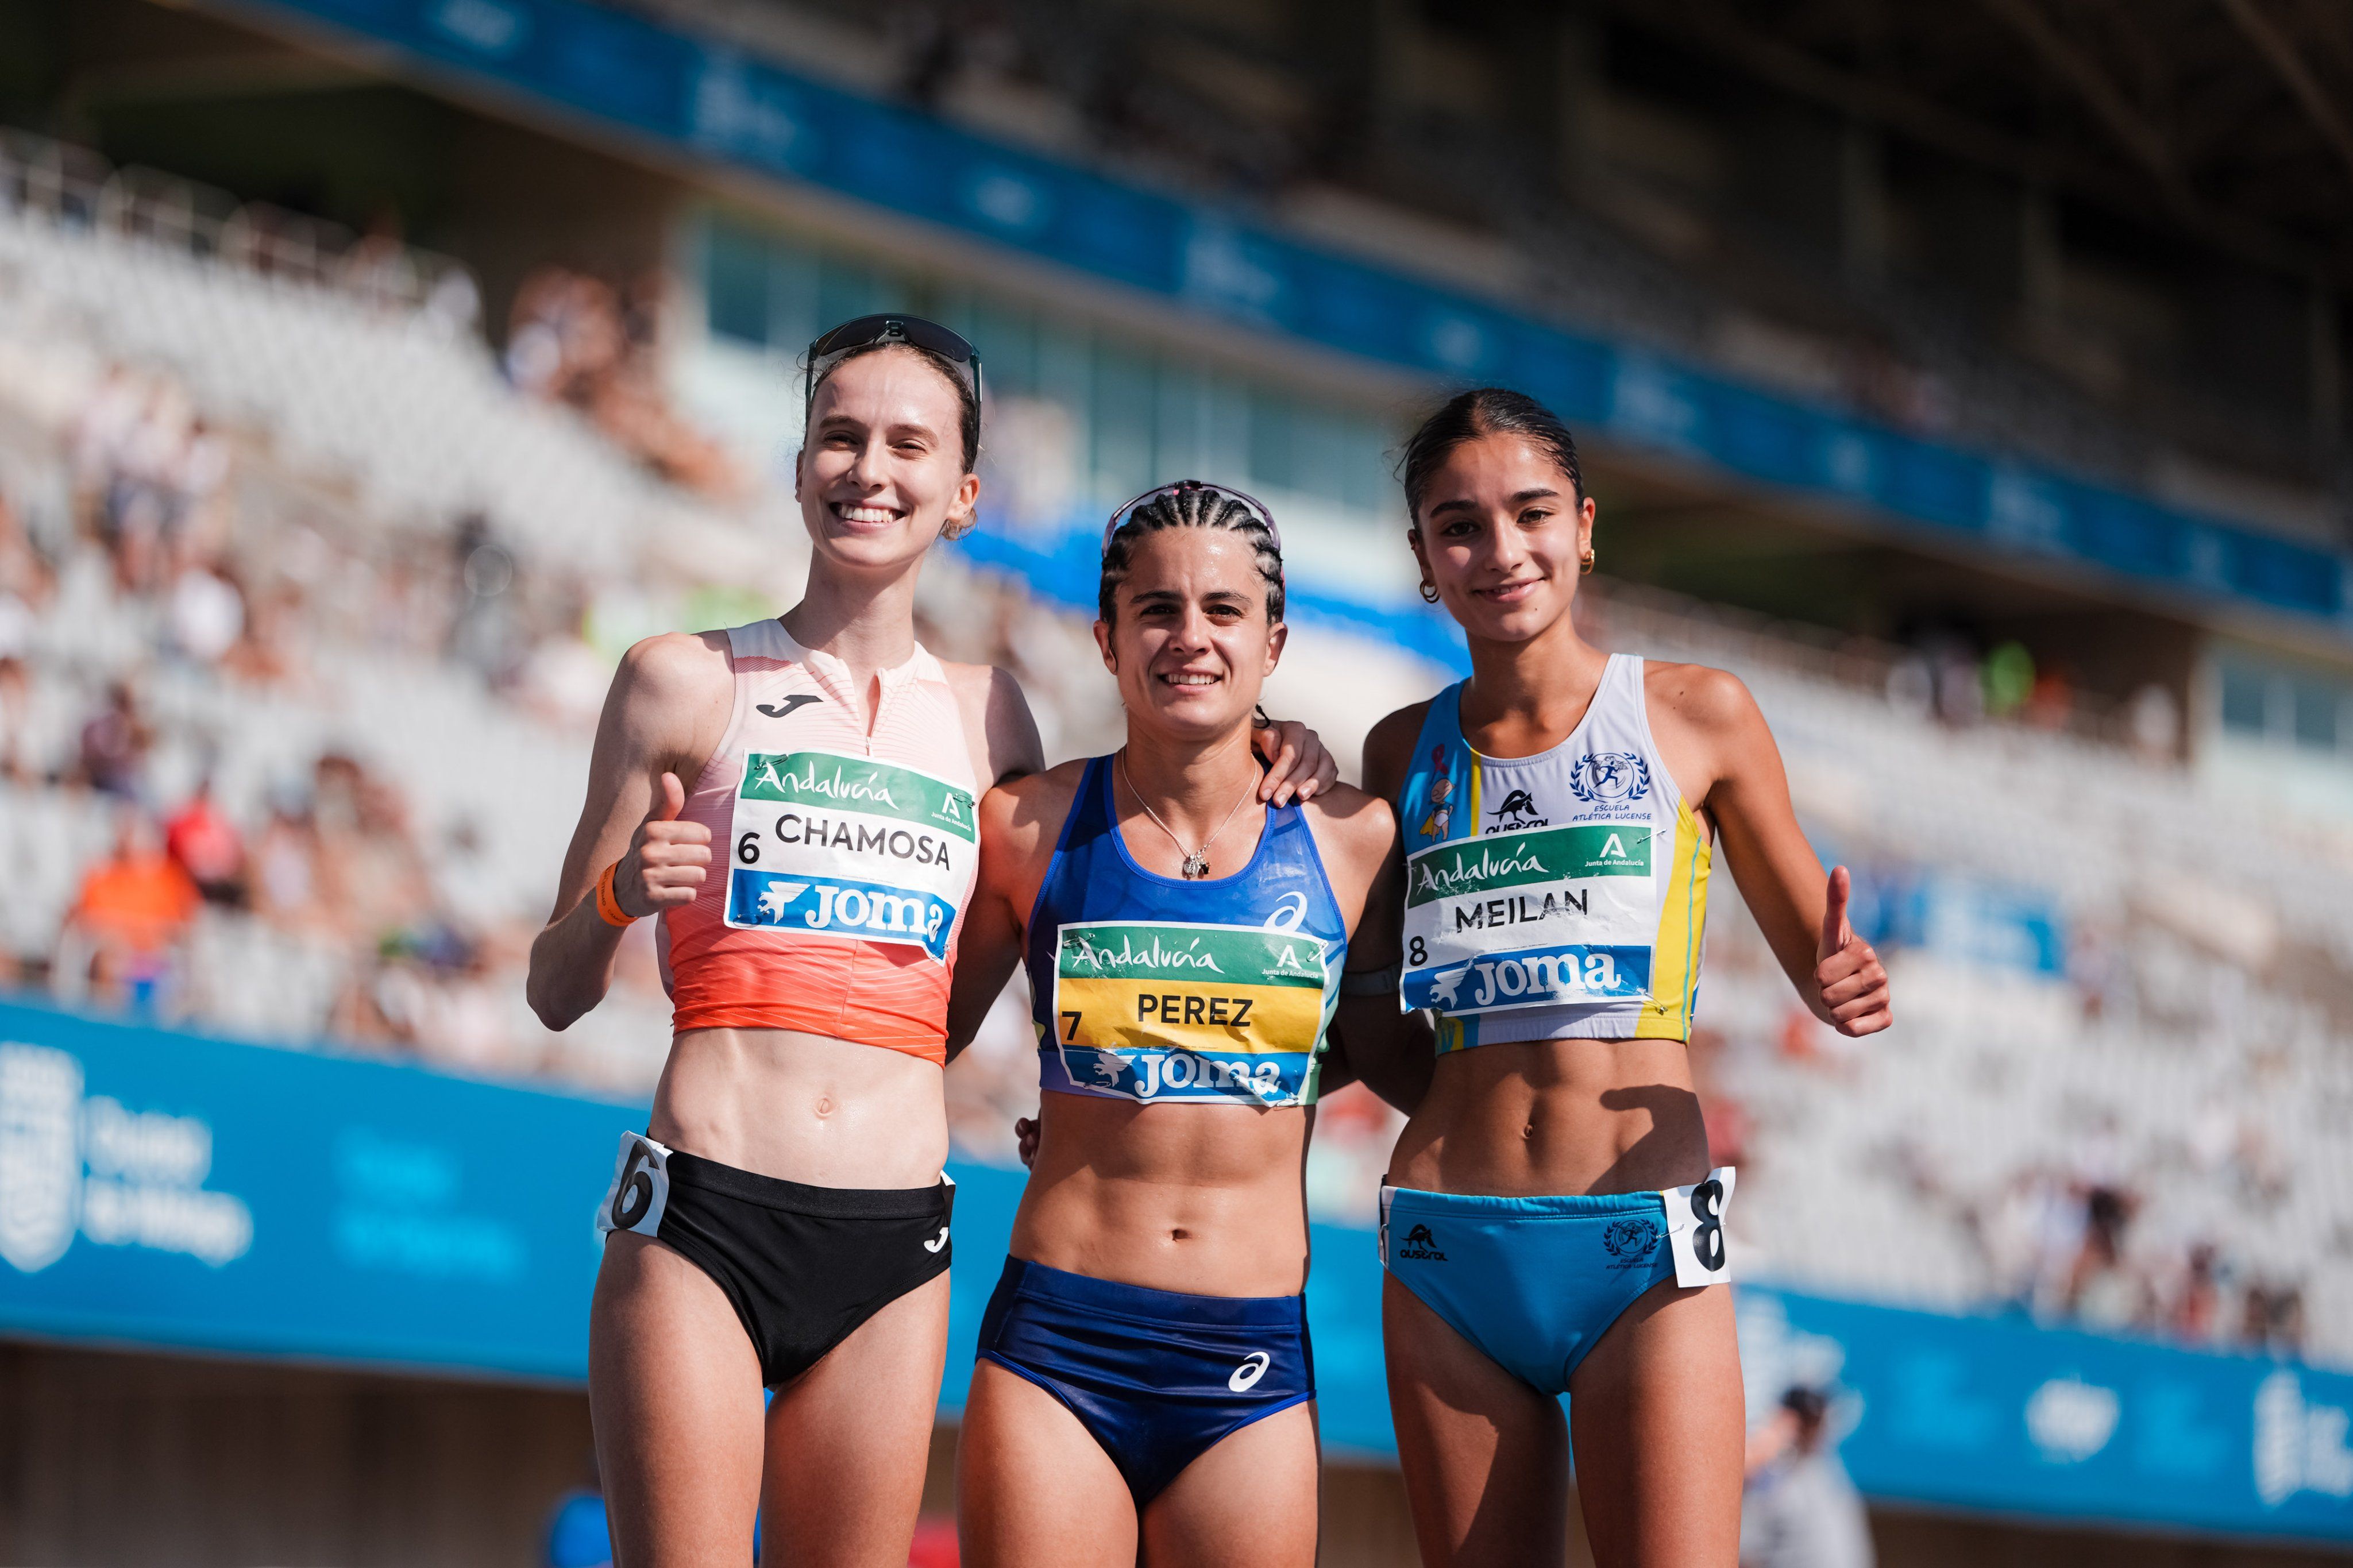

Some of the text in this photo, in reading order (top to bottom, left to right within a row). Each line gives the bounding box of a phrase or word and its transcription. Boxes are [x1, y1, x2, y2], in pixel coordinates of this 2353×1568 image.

[754, 760, 900, 810] Andalucía
[931, 811, 945, 821] Junta
[1572, 812, 1611, 822] ATLÉTICA
[1594, 804, 1630, 812] ESCUELA
[738, 832, 760, 864] 6
[775, 814, 950, 871] CHAMOSA
[1416, 841, 1550, 896] Andalucía
[805, 885, 943, 943] Joma
[1455, 889, 1588, 933] MEILAN
[1071, 934, 1226, 974] Andalucía
[1409, 936, 1428, 967] 8
[1289, 970, 1319, 979] Andalucía
[1474, 953, 1622, 1006] Joma
[1062, 1011, 1082, 1041] 7
[1138, 994, 1253, 1027] PEREZ
[1134, 1053, 1281, 1098] Joma
[611, 1139, 660, 1229] 6
[1690, 1179, 1724, 1272] 8
